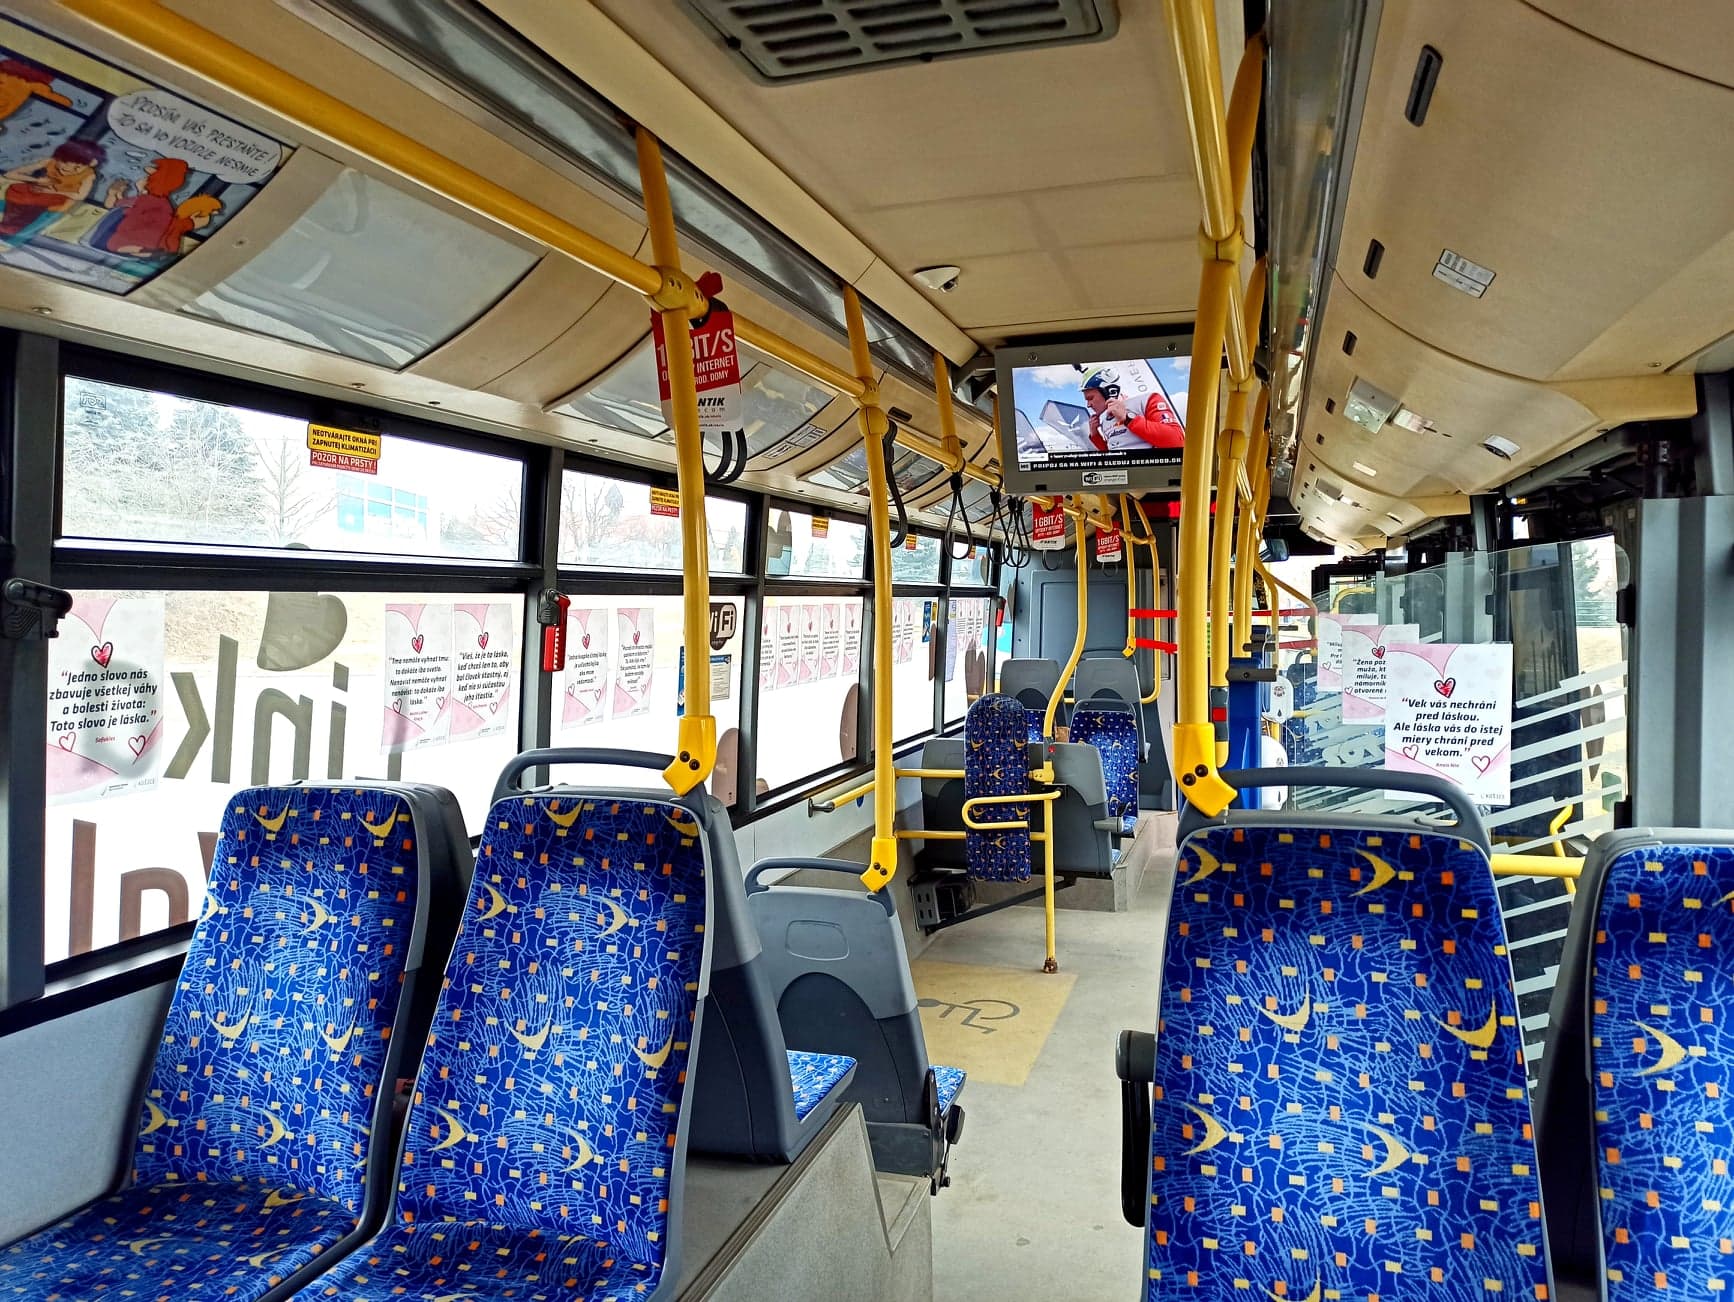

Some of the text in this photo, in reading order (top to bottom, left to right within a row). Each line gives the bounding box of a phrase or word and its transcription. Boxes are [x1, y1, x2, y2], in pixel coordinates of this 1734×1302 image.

[697, 355, 735, 374] INTERNET
[710, 370, 729, 381] DOMY
[312, 451, 337, 463] POZOR
[338, 456, 350, 465] NA
[100, 669, 128, 681] slovo
[130, 668, 148, 680] nás
[49, 683, 158, 700] zbavuje všetkej váhy
[62, 706, 69, 715] a
[72, 701, 109, 714] bolesti
[1429, 699, 1447, 709] vás
[1450, 700, 1496, 710] nechráni
[1416, 711, 1480, 722] pred láskou.
[50, 720, 75, 732] Toto
[77, 717, 106, 730] slovo
[107, 717, 118, 729] je
[1393, 722, 1504, 736] Ale láska vás do istej
[1402, 735, 1494, 748] miery chráni pred
